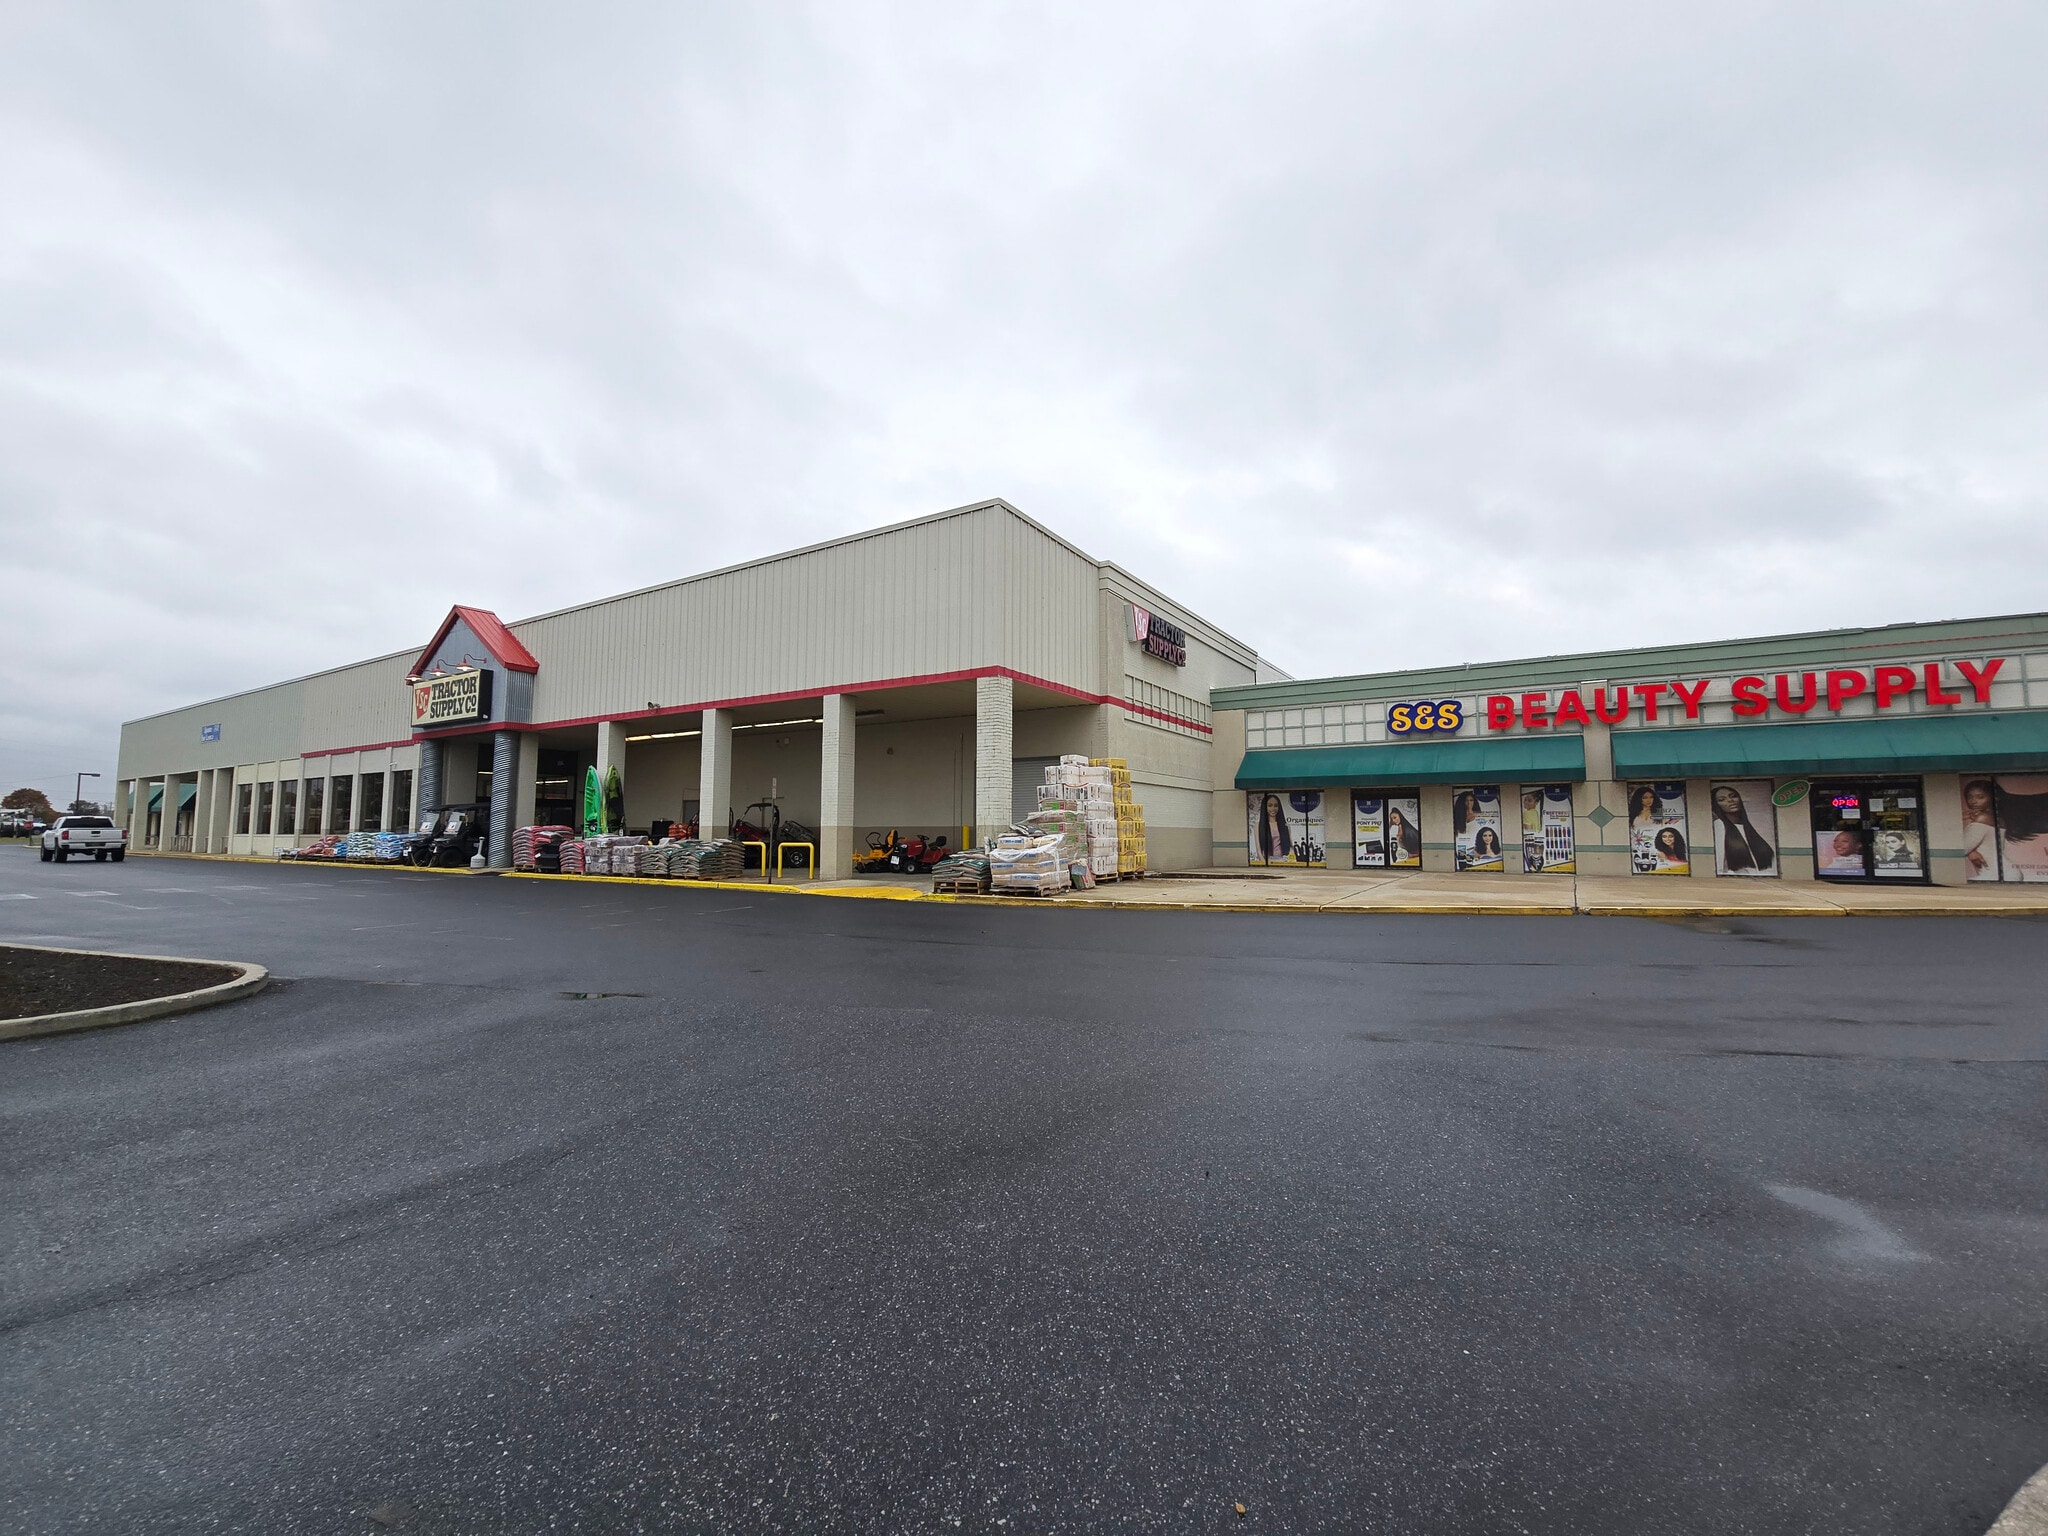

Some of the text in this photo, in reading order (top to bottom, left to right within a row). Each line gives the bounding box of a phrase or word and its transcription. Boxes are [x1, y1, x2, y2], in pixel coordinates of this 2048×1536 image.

[1133, 604, 1147, 639] TSC
[1149, 613, 1185, 648] TRACTOR
[1148, 634, 1178, 663] SUPPLY
[432, 676, 477, 700] TRACTOR
[1388, 658, 2007, 733] S&S BEAUTY SUPPLY
[415, 689, 428, 712] TSC
[430, 695, 465, 719] SUPPLY
[1778, 785, 1805, 802] OPEN
[1832, 797, 1859, 807] OPEN
[1286, 816, 1322, 824] Organque
